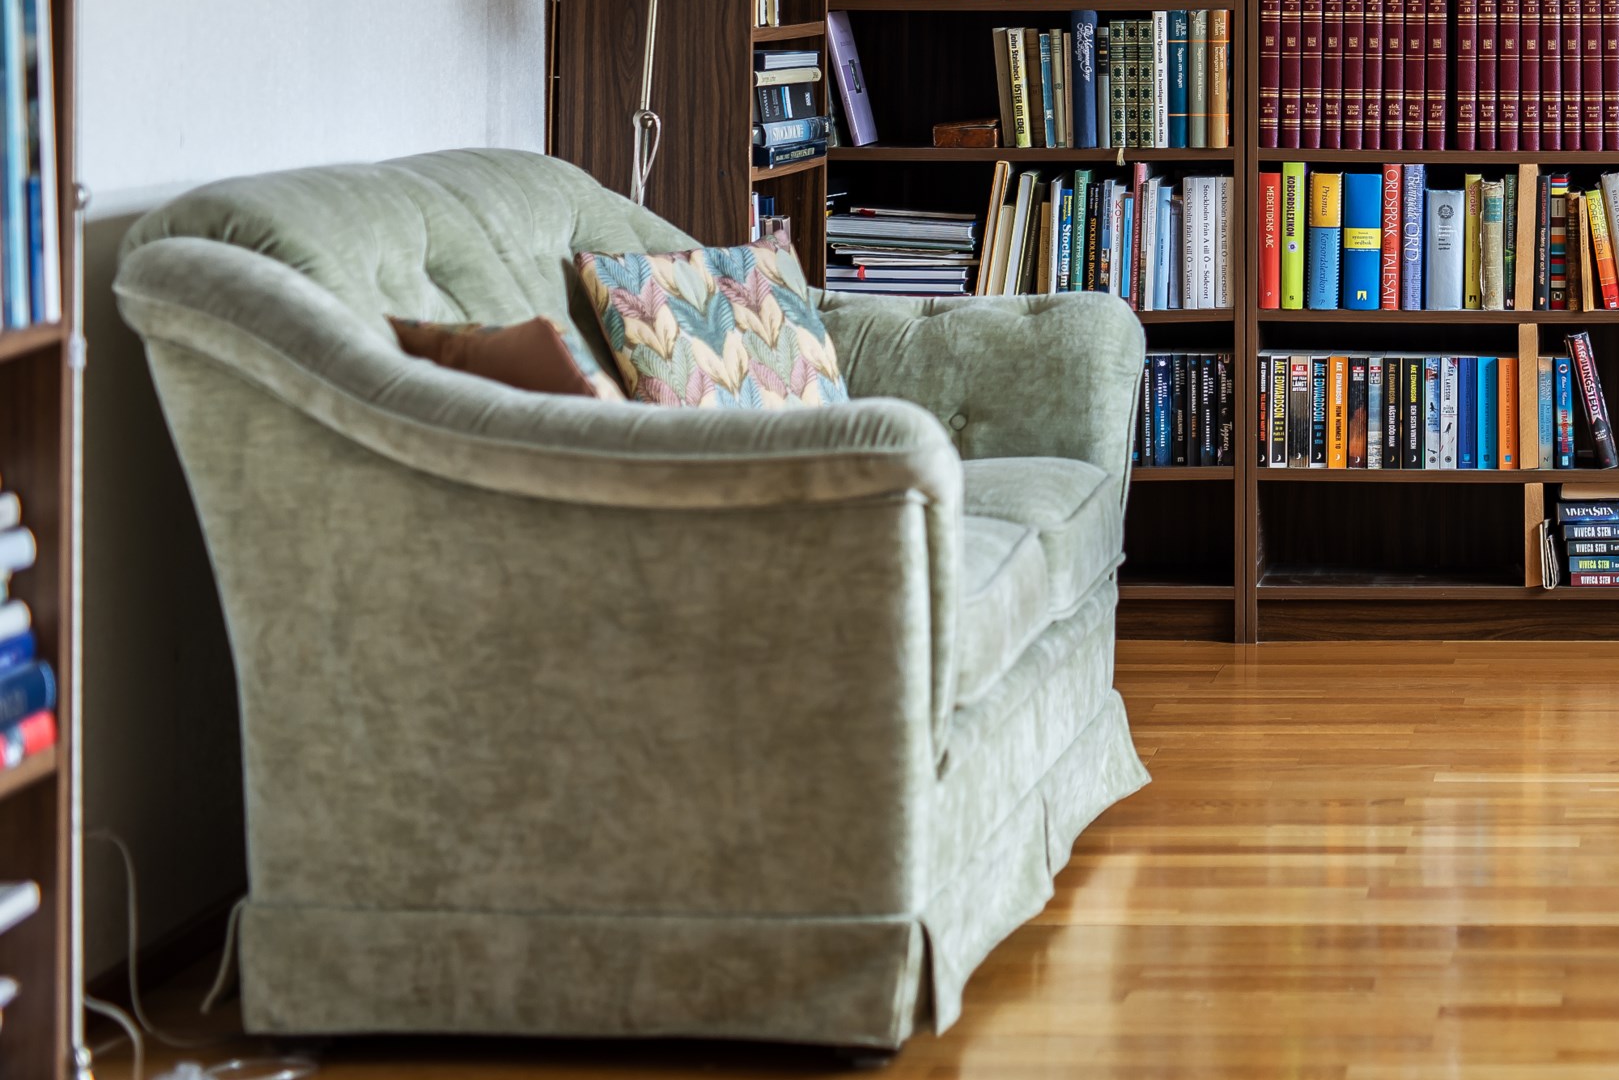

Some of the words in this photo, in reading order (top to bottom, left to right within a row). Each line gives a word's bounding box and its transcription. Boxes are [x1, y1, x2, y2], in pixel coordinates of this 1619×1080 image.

[1011, 34, 1019, 49] John
[1011, 50, 1021, 81] Steinbeck
[1015, 104, 1024, 116] OM
[1016, 118, 1025, 135] EDEN
[1202, 184, 1211, 221] Stockholm
[1266, 186, 1275, 232] MEDELTIDENS
[1286, 176, 1296, 236] KORSORDSLEXIKON
[1321, 186, 1330, 216] Prismas
[1088, 218, 1097, 260] STOCKHOLMS
[1203, 223, 1211, 237] från
[1266, 233, 1275, 248] ABC
[1405, 223, 1418, 261] ORD
[1060, 224, 1071, 286] Stockholm
[1203, 245, 1211, 254] till
[1319, 233, 1330, 294] Korsordslexikon
[1203, 270, 1211, 300] Söderort
[1275, 361, 1287, 374] ÅKE
[1314, 363, 1327, 376] ÅKE
[1274, 376, 1285, 418] EDWARDSON
[1314, 378, 1324, 422] EDWARDSON
[1220, 422, 1232, 451] Tiggaren
